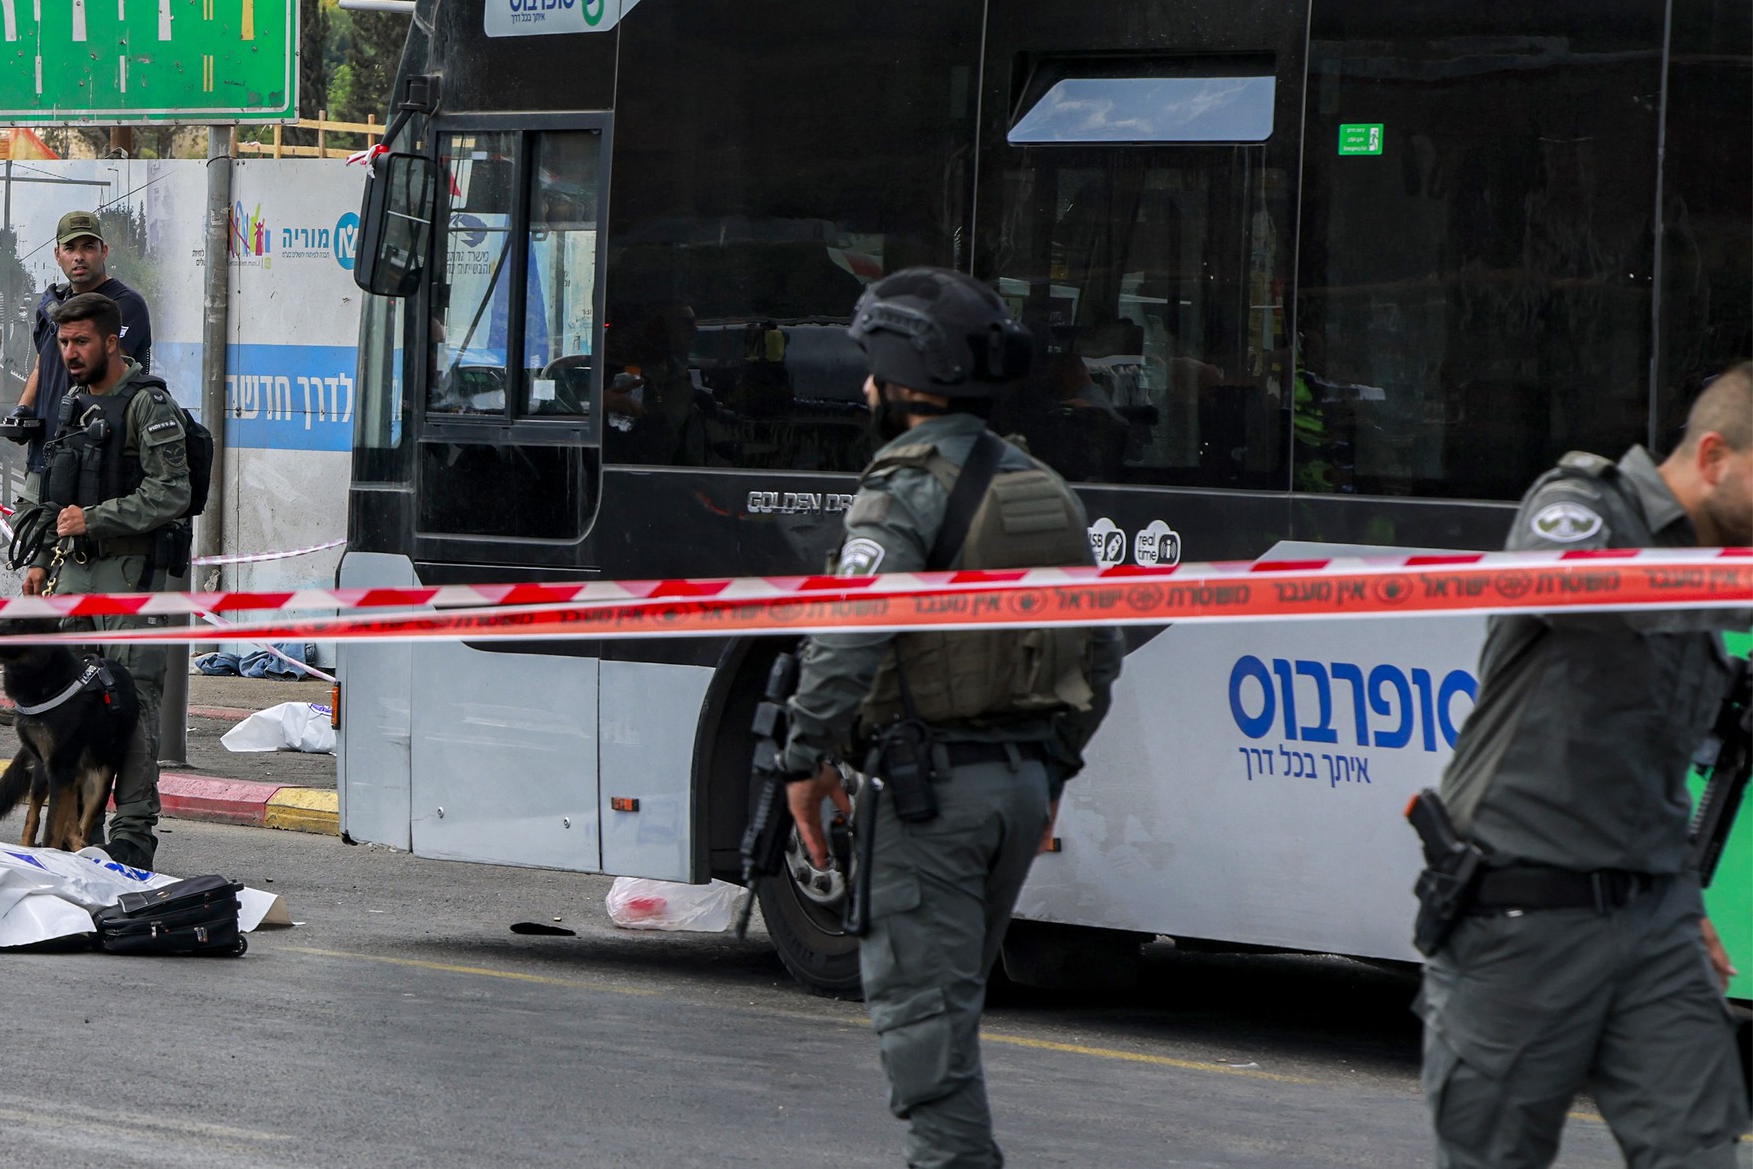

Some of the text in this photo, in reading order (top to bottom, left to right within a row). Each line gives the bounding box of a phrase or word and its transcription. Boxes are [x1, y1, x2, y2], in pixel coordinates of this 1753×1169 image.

[282, 227, 330, 249] מוריה
[225, 372, 353, 430] לדרך חדשה
[747, 491, 858, 513] GOLDEN DR
[1138, 532, 1156, 546] real
[1138, 546, 1157, 561] time
[1274, 570, 1621, 607] משטרת ישראל אין מעבר
[1709, 566, 1741, 592] אין
[912, 585, 1251, 617] משטרת ישראל אין מעבר
[1229, 655, 1479, 752] סופרבוס
[1238, 744, 1372, 788] איתך בכל דרך
